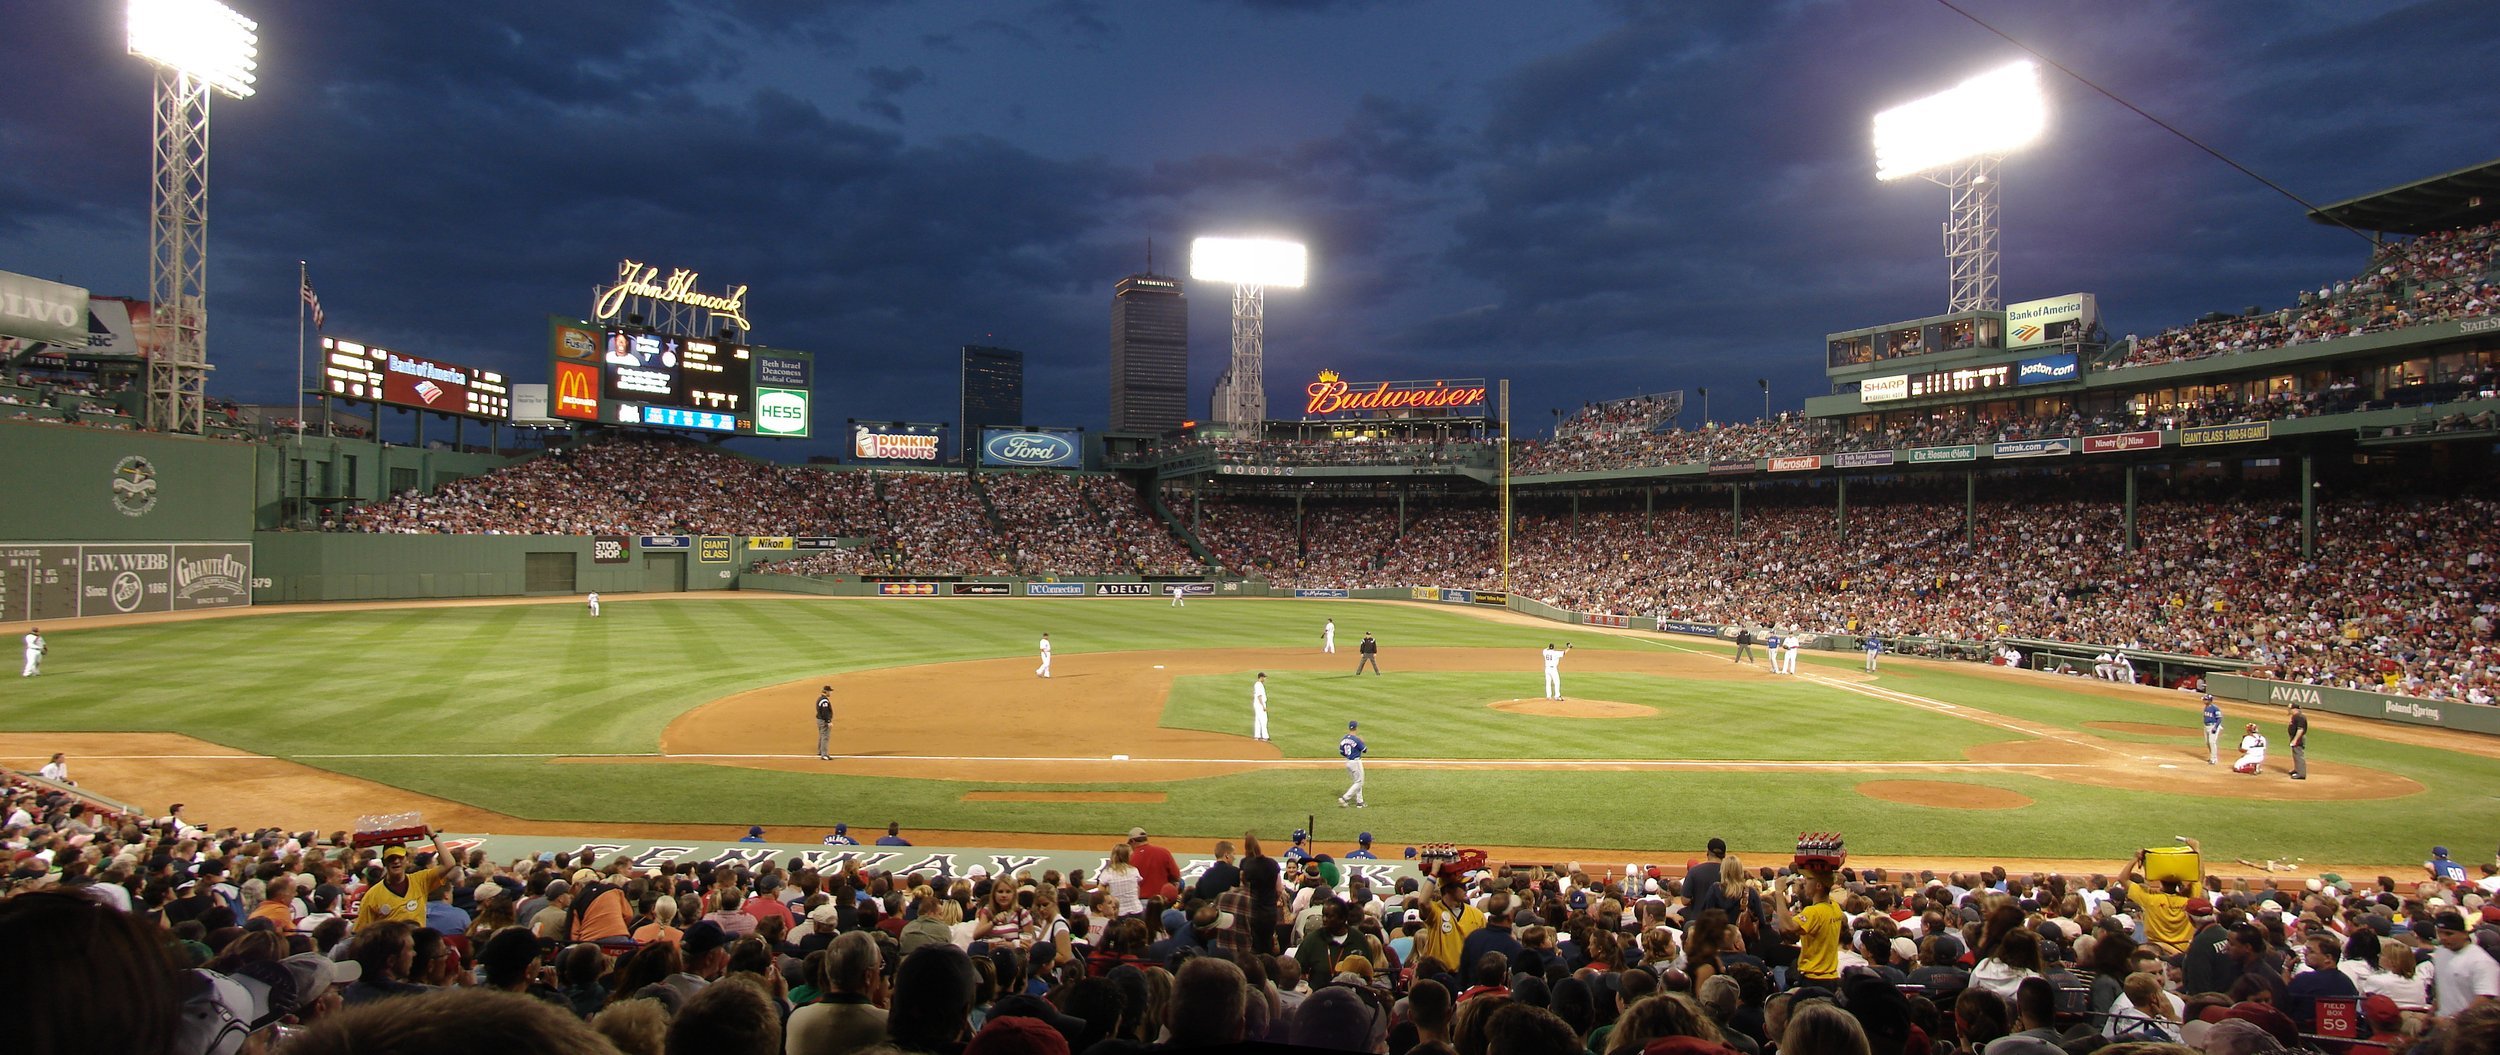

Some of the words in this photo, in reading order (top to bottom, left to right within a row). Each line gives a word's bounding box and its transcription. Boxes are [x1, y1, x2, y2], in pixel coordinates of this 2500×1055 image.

[597, 259, 662, 319] John
[660, 268, 751, 331] Hancock
[2010, 309, 2032, 320] Bank
[2033, 307, 2042, 317] of
[2043, 303, 2080, 315] America
[2460, 320, 2489, 333] STATE
[30, 356, 70, 367] FUTUR
[762, 359, 779, 368] Beth
[781, 361, 801, 370] Israel
[389, 354, 416, 376] Bank
[417, 361, 428, 378] of
[428, 362, 466, 386] America
[762, 366, 802, 377] Deaconess
[2020, 362, 2075, 377] boston.com
[762, 375, 785, 383] Medical
[1864, 380, 1905, 392] SHARP
[1307, 380, 1486, 414] Budweiser
[762, 405, 801, 419] HESS
[879, 434, 938, 447] DUNKIN'
[2183, 432, 2202, 444] GIANT
[2202, 430, 2224, 442] GLASS
[2247, 427, 2265, 438] GIANT
[1003, 437, 1056, 459] Ford
[1998, 443, 2042, 452] amtrak.com
[2095, 439, 2116, 448] Ninety
[2128, 437, 2144, 445] Nine
[879, 447, 935, 460] DONUTS
[1914, 451, 1926, 460] The
[1927, 450, 1950, 459] Boston
[1951, 448, 1971, 458] Globe
[1773, 458, 1814, 470] Microsoft
[703, 540, 728, 549] GIANT
[758, 539, 784, 548] Nikon
[703, 549, 728, 558] GLASS
[119, 553, 168, 570] WEBB
[177, 557, 223, 587] GRANITE
[223, 553, 246, 584] CITY
[719, 570, 731, 579] 420
[252, 578, 272, 588] 379
[1042, 584, 1081, 594] Connection
[1111, 585, 1149, 593] DELTA
[1223, 583, 1237, 591] 380
[85, 586, 108, 597] Since
[2270, 686, 2322, 705] AVAYA
[2385, 699, 2412, 715] Poland
[2413, 703, 2440, 721] Spring
[2447, 867, 2466, 881] 88
[2323, 1002, 2346, 1010] FIELD
[2323, 1018, 2348, 1031] 59
